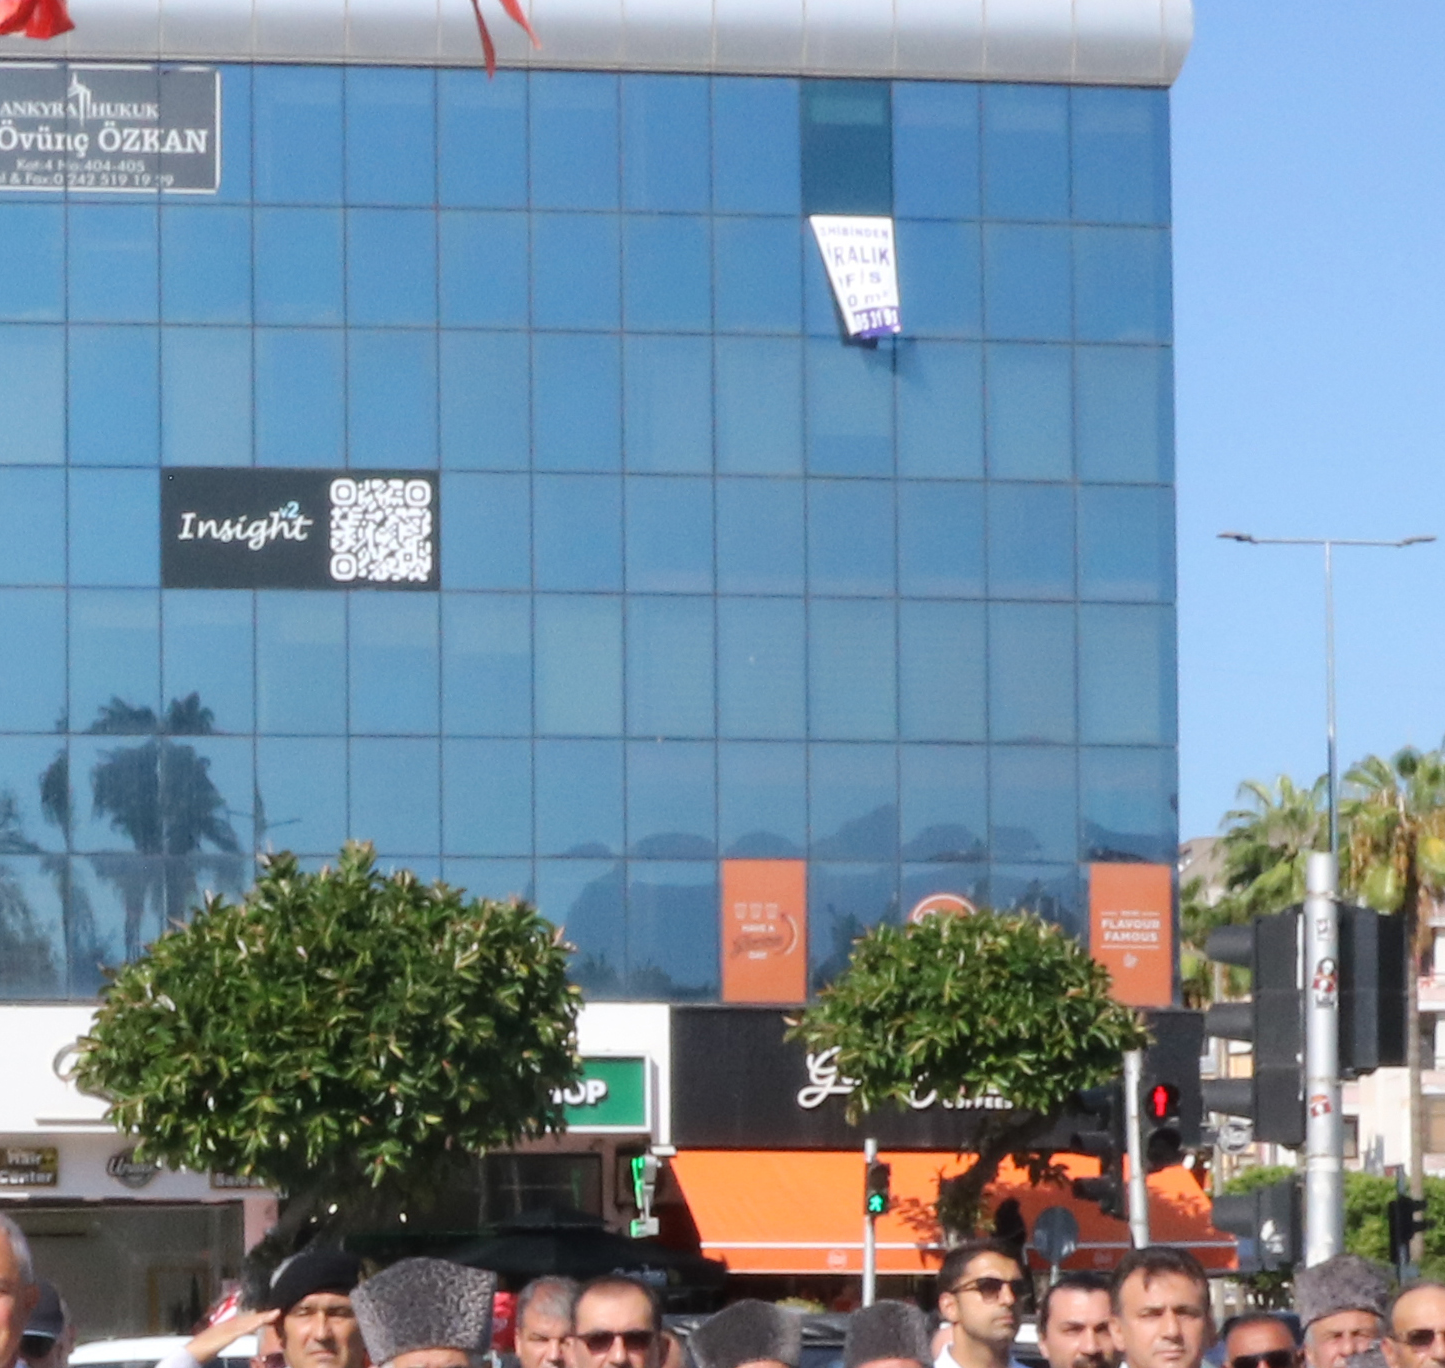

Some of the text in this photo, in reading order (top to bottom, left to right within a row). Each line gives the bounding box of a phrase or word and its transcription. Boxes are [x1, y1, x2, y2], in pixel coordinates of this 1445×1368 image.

[0, 101, 159, 119] ANKYRA HUKUK
[98, 121, 208, 153] ÖZKAN
[10, 171, 22, 184] &
[178, 511, 314, 550] Insight
[1104, 931, 1158, 942] FAMOUS
